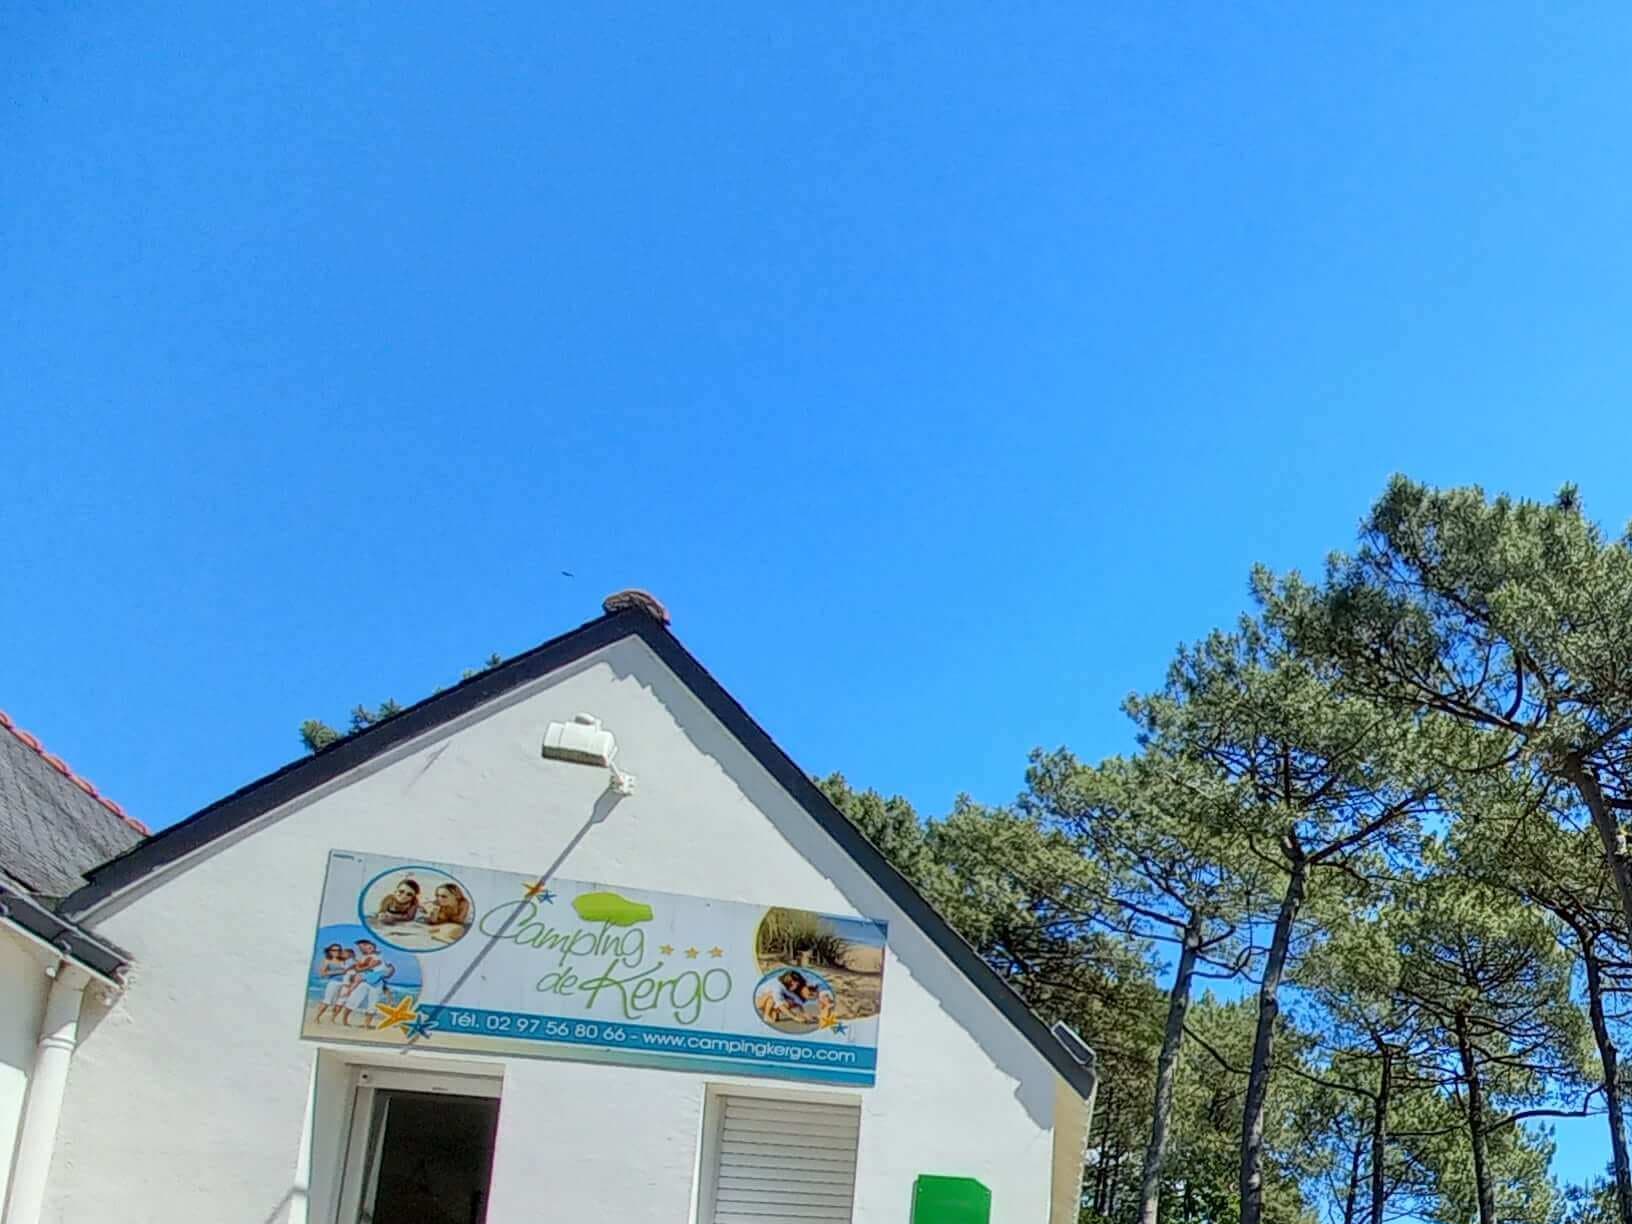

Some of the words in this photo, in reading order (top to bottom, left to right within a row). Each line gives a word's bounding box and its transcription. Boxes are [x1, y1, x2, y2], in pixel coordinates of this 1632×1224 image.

[479, 900, 645, 968] Camping
[536, 966, 579, 996] de
[578, 958, 733, 1025] Kergo
[450, 1011, 480, 1028] Tél.
[486, 1015, 511, 1031] 02
[516, 1018, 541, 1033] 97
[545, 1020, 570, 1036] 56
[574, 1023, 599, 1039] 80
[603, 1026, 626, 1041] 66
[642, 1031, 857, 1063] www.campingkergo.com
